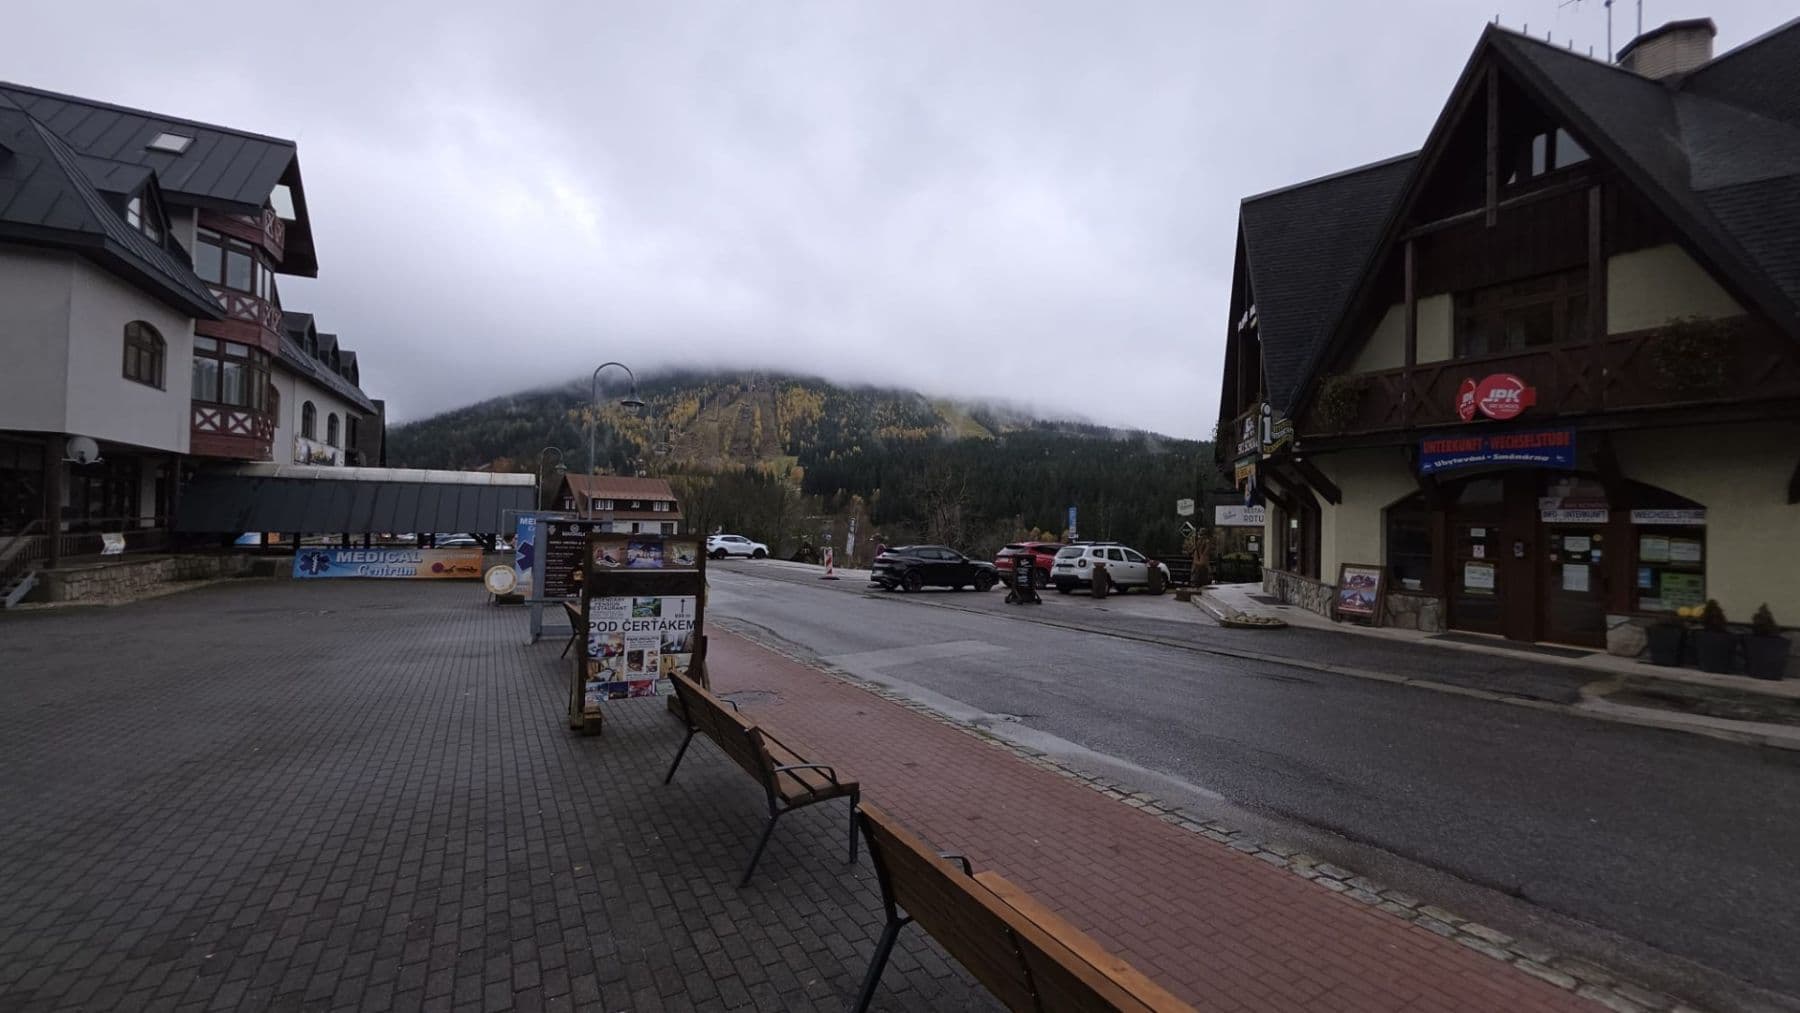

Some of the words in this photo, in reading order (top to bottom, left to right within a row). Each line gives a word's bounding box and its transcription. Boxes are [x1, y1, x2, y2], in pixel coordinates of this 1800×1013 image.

[1489, 388, 1520, 402] JPK
[1423, 438, 1484, 454] UNTERKUNFT
[1488, 432, 1569, 450] WECHSELSTUBE
[519, 517, 537, 525] ME
[336, 551, 422, 563] MEDICAL
[356, 564, 416, 577] Centrum
[588, 621, 617, 632] POD
[622, 618, 696, 631] ČERŤÁKEM
